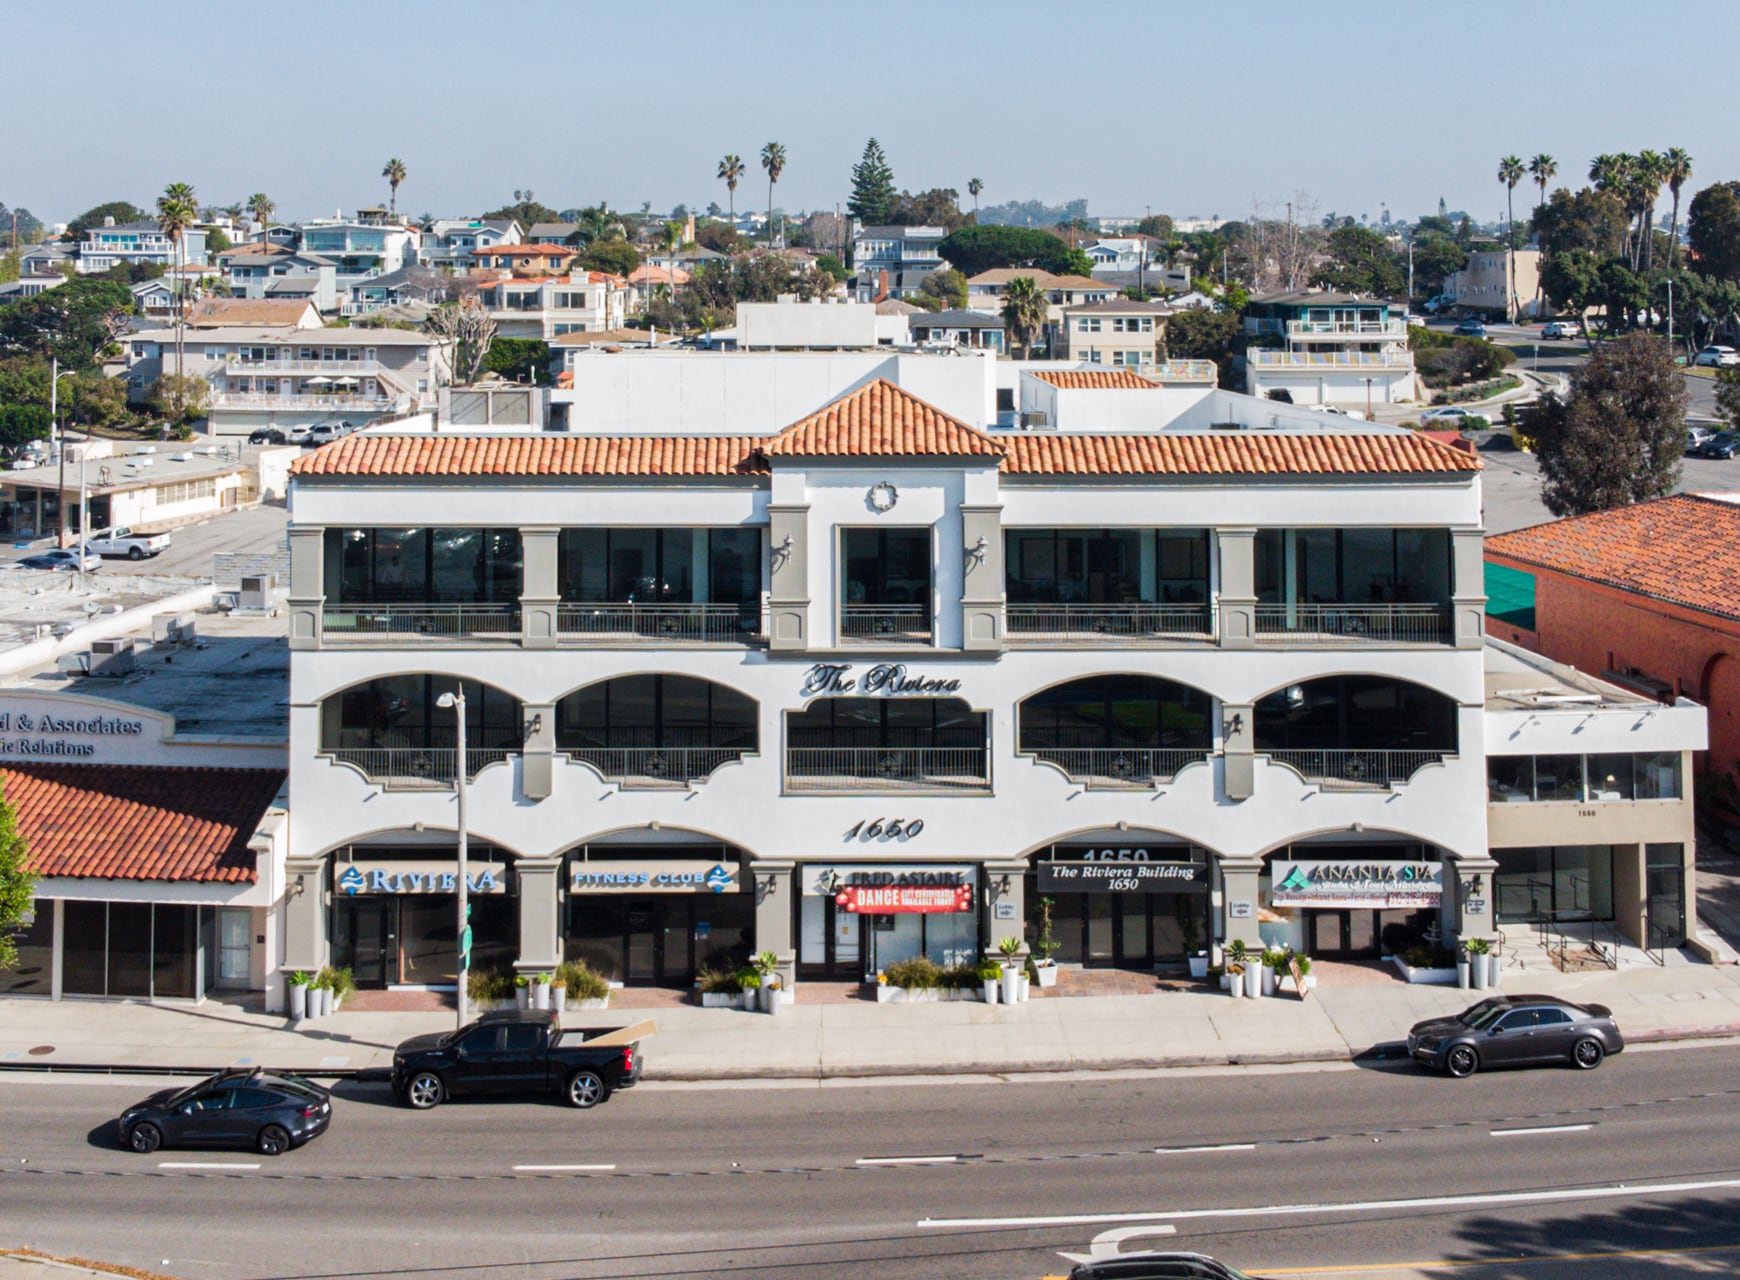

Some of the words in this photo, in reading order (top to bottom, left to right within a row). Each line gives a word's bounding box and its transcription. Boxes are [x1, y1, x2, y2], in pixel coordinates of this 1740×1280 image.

[803, 663, 856, 693] The
[864, 663, 962, 693] Riviera
[16, 713, 34, 732] &
[40, 714, 143, 735] Associates
[18, 738, 95, 756] Relations
[842, 817, 924, 839] 1650
[1083, 849, 1150, 862] 1650
[575, 871, 650, 884] FITNESS
[657, 871, 705, 884] CLUB
[852, 871, 895, 885] FRED
[898, 871, 965, 885] ASTAIRE
[1052, 865, 1079, 878] The
[1082, 865, 1133, 878] Riviera
[1137, 865, 1195, 881] Building
[1313, 864, 1398, 881] ANANTA
[1403, 864, 1436, 880] SPA
[1107, 878, 1139, 891] 1650
[857, 889, 900, 907] DANCE
